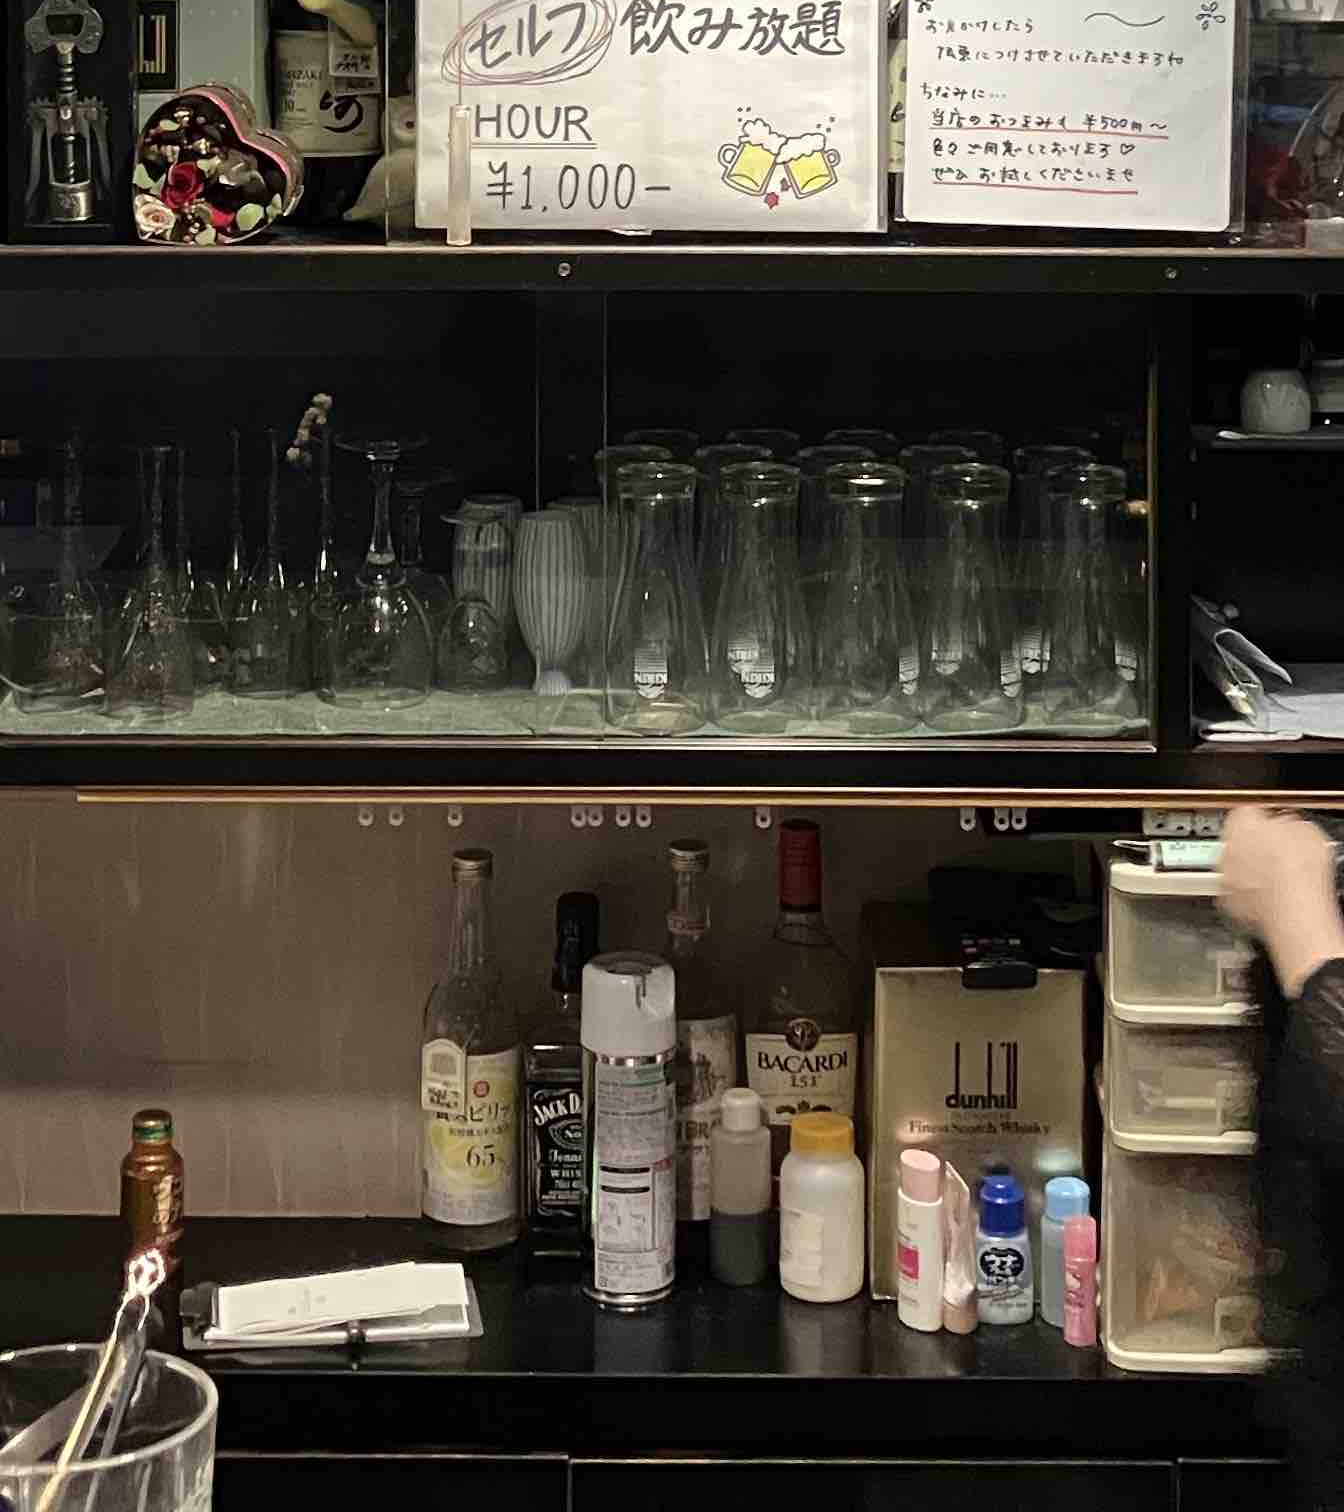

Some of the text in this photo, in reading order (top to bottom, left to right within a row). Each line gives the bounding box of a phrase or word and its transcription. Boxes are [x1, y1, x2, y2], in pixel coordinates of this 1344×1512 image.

[468, 1, 588, 70] セルフ
[474, 102, 594, 142] HOUR
[757, 1050, 849, 1075] BACARDI
[945, 1042, 1018, 1110] dunhill
[533, 1098, 570, 1126] JACK
